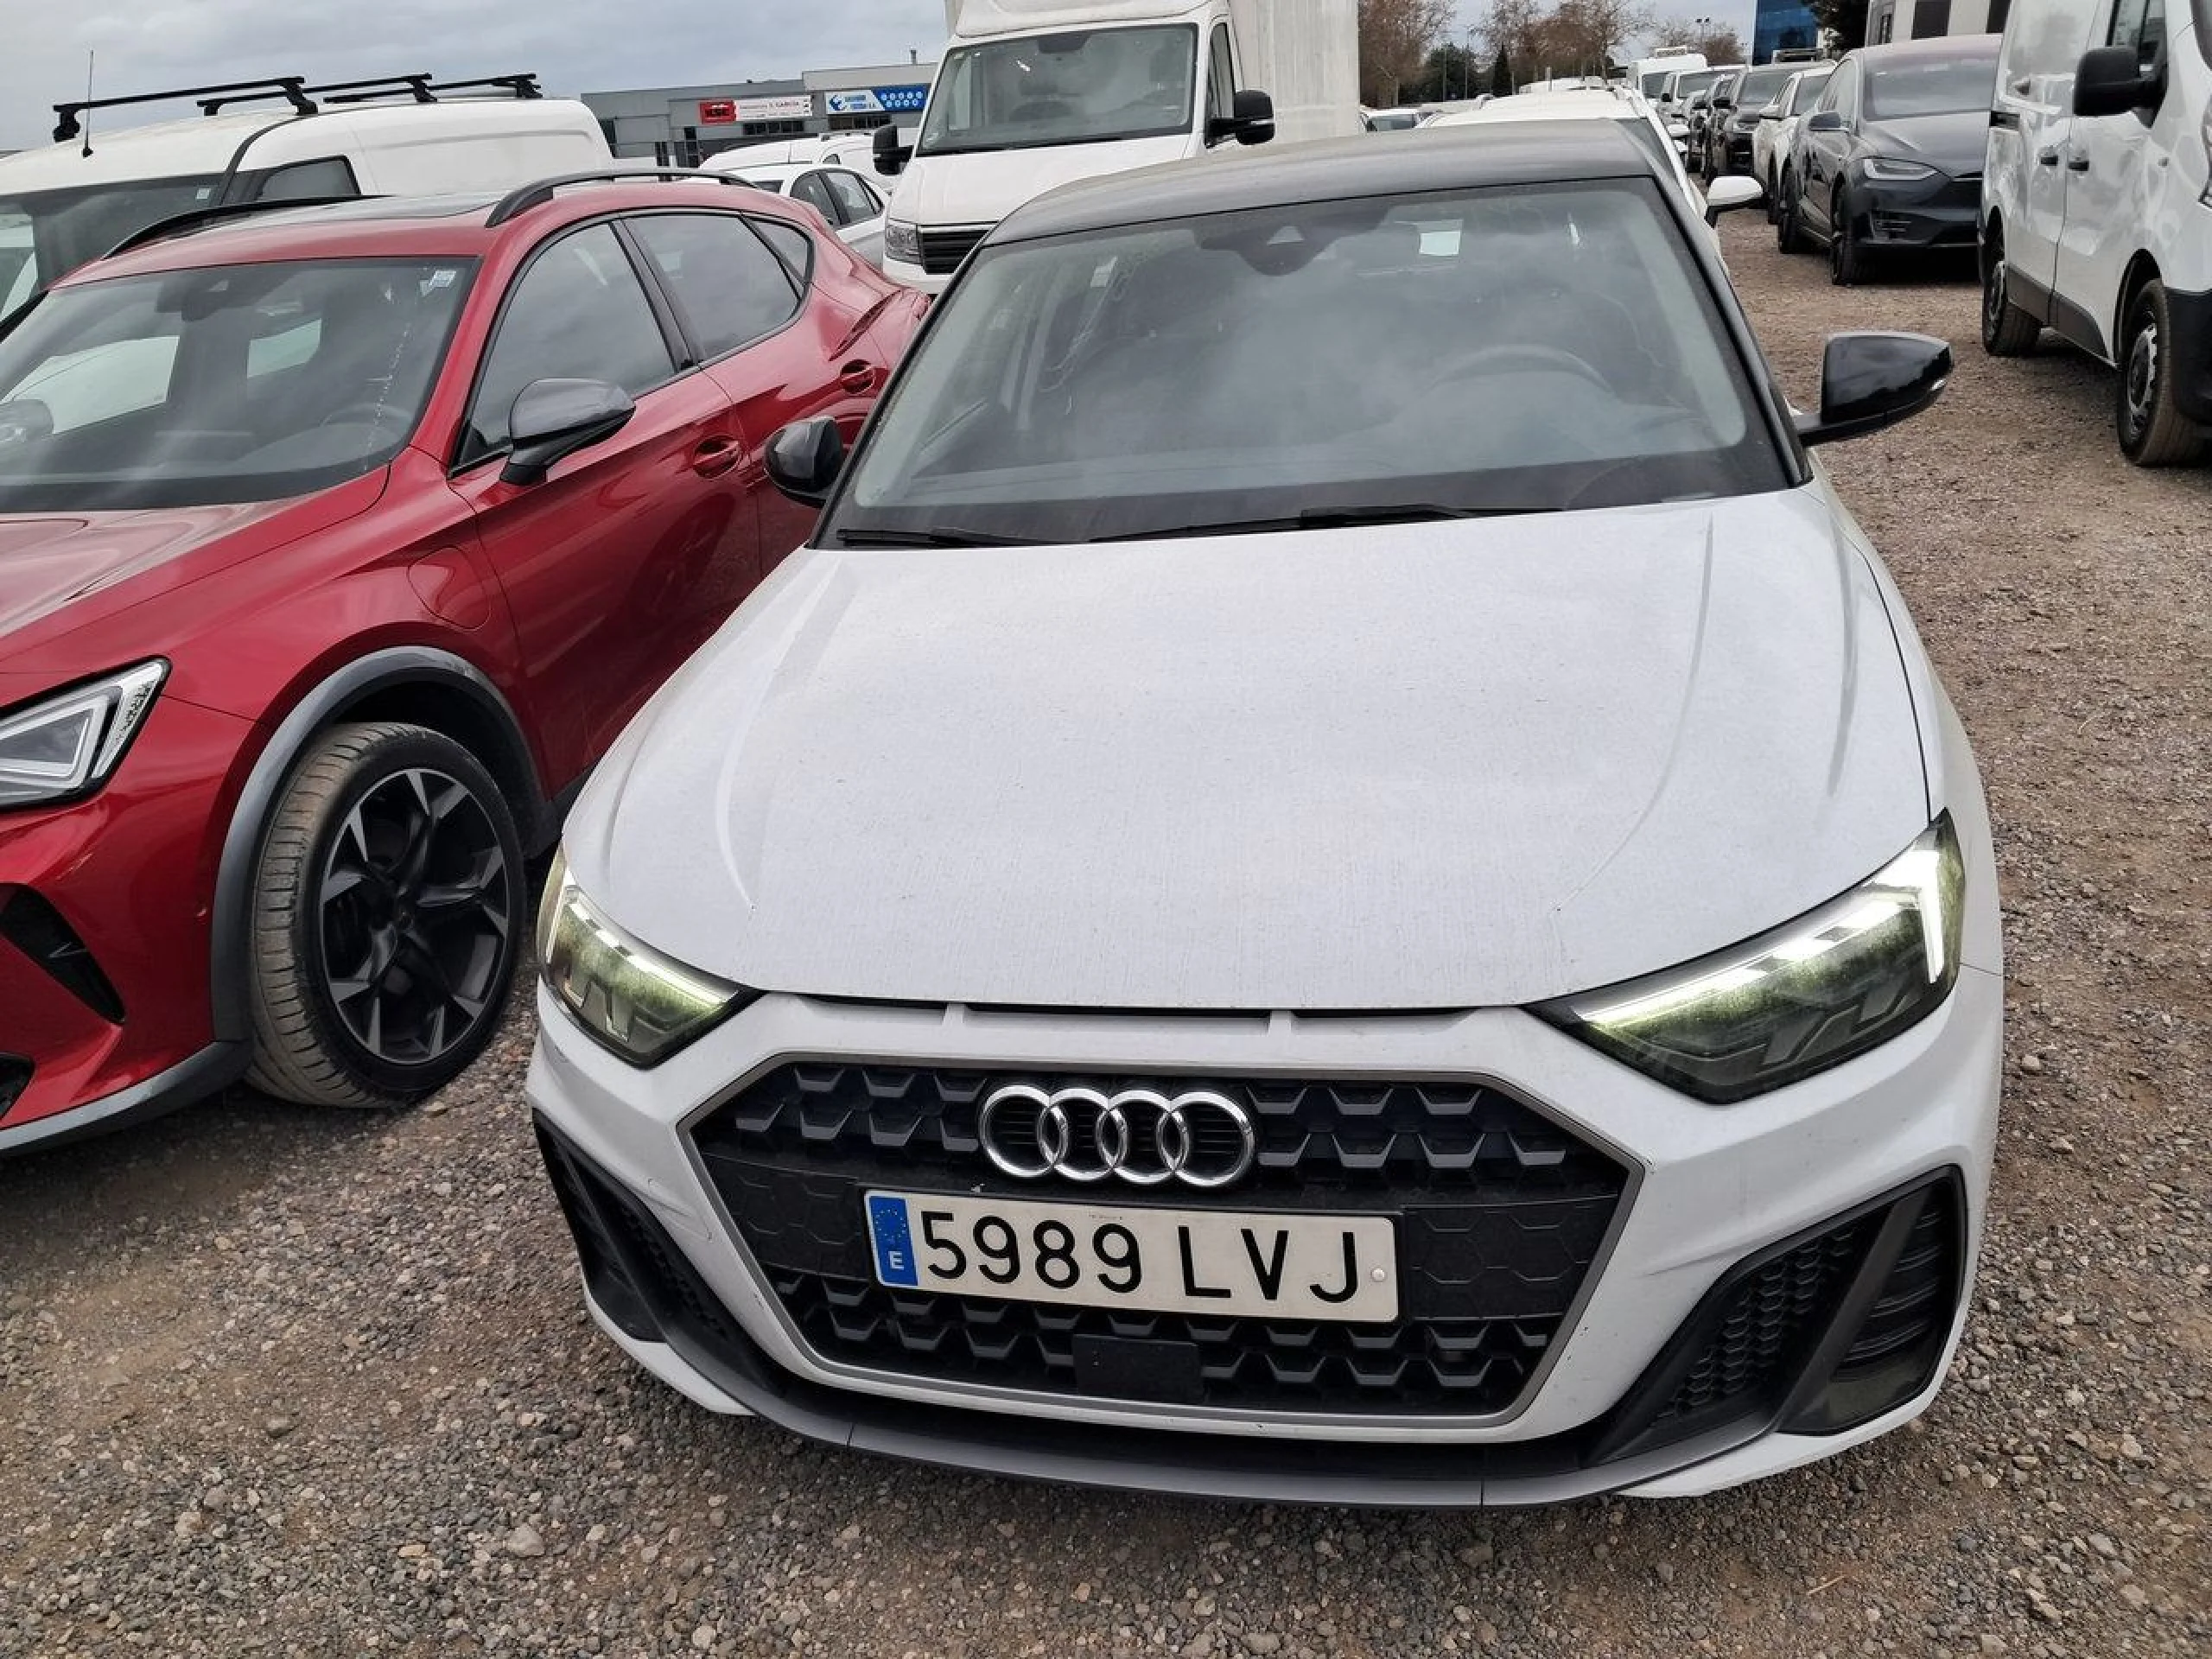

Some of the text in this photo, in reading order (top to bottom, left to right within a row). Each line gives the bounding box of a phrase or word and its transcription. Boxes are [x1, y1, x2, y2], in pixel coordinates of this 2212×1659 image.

[888, 1250, 905, 1269] E
[921, 1211, 1359, 1303] 5989 LVJ
